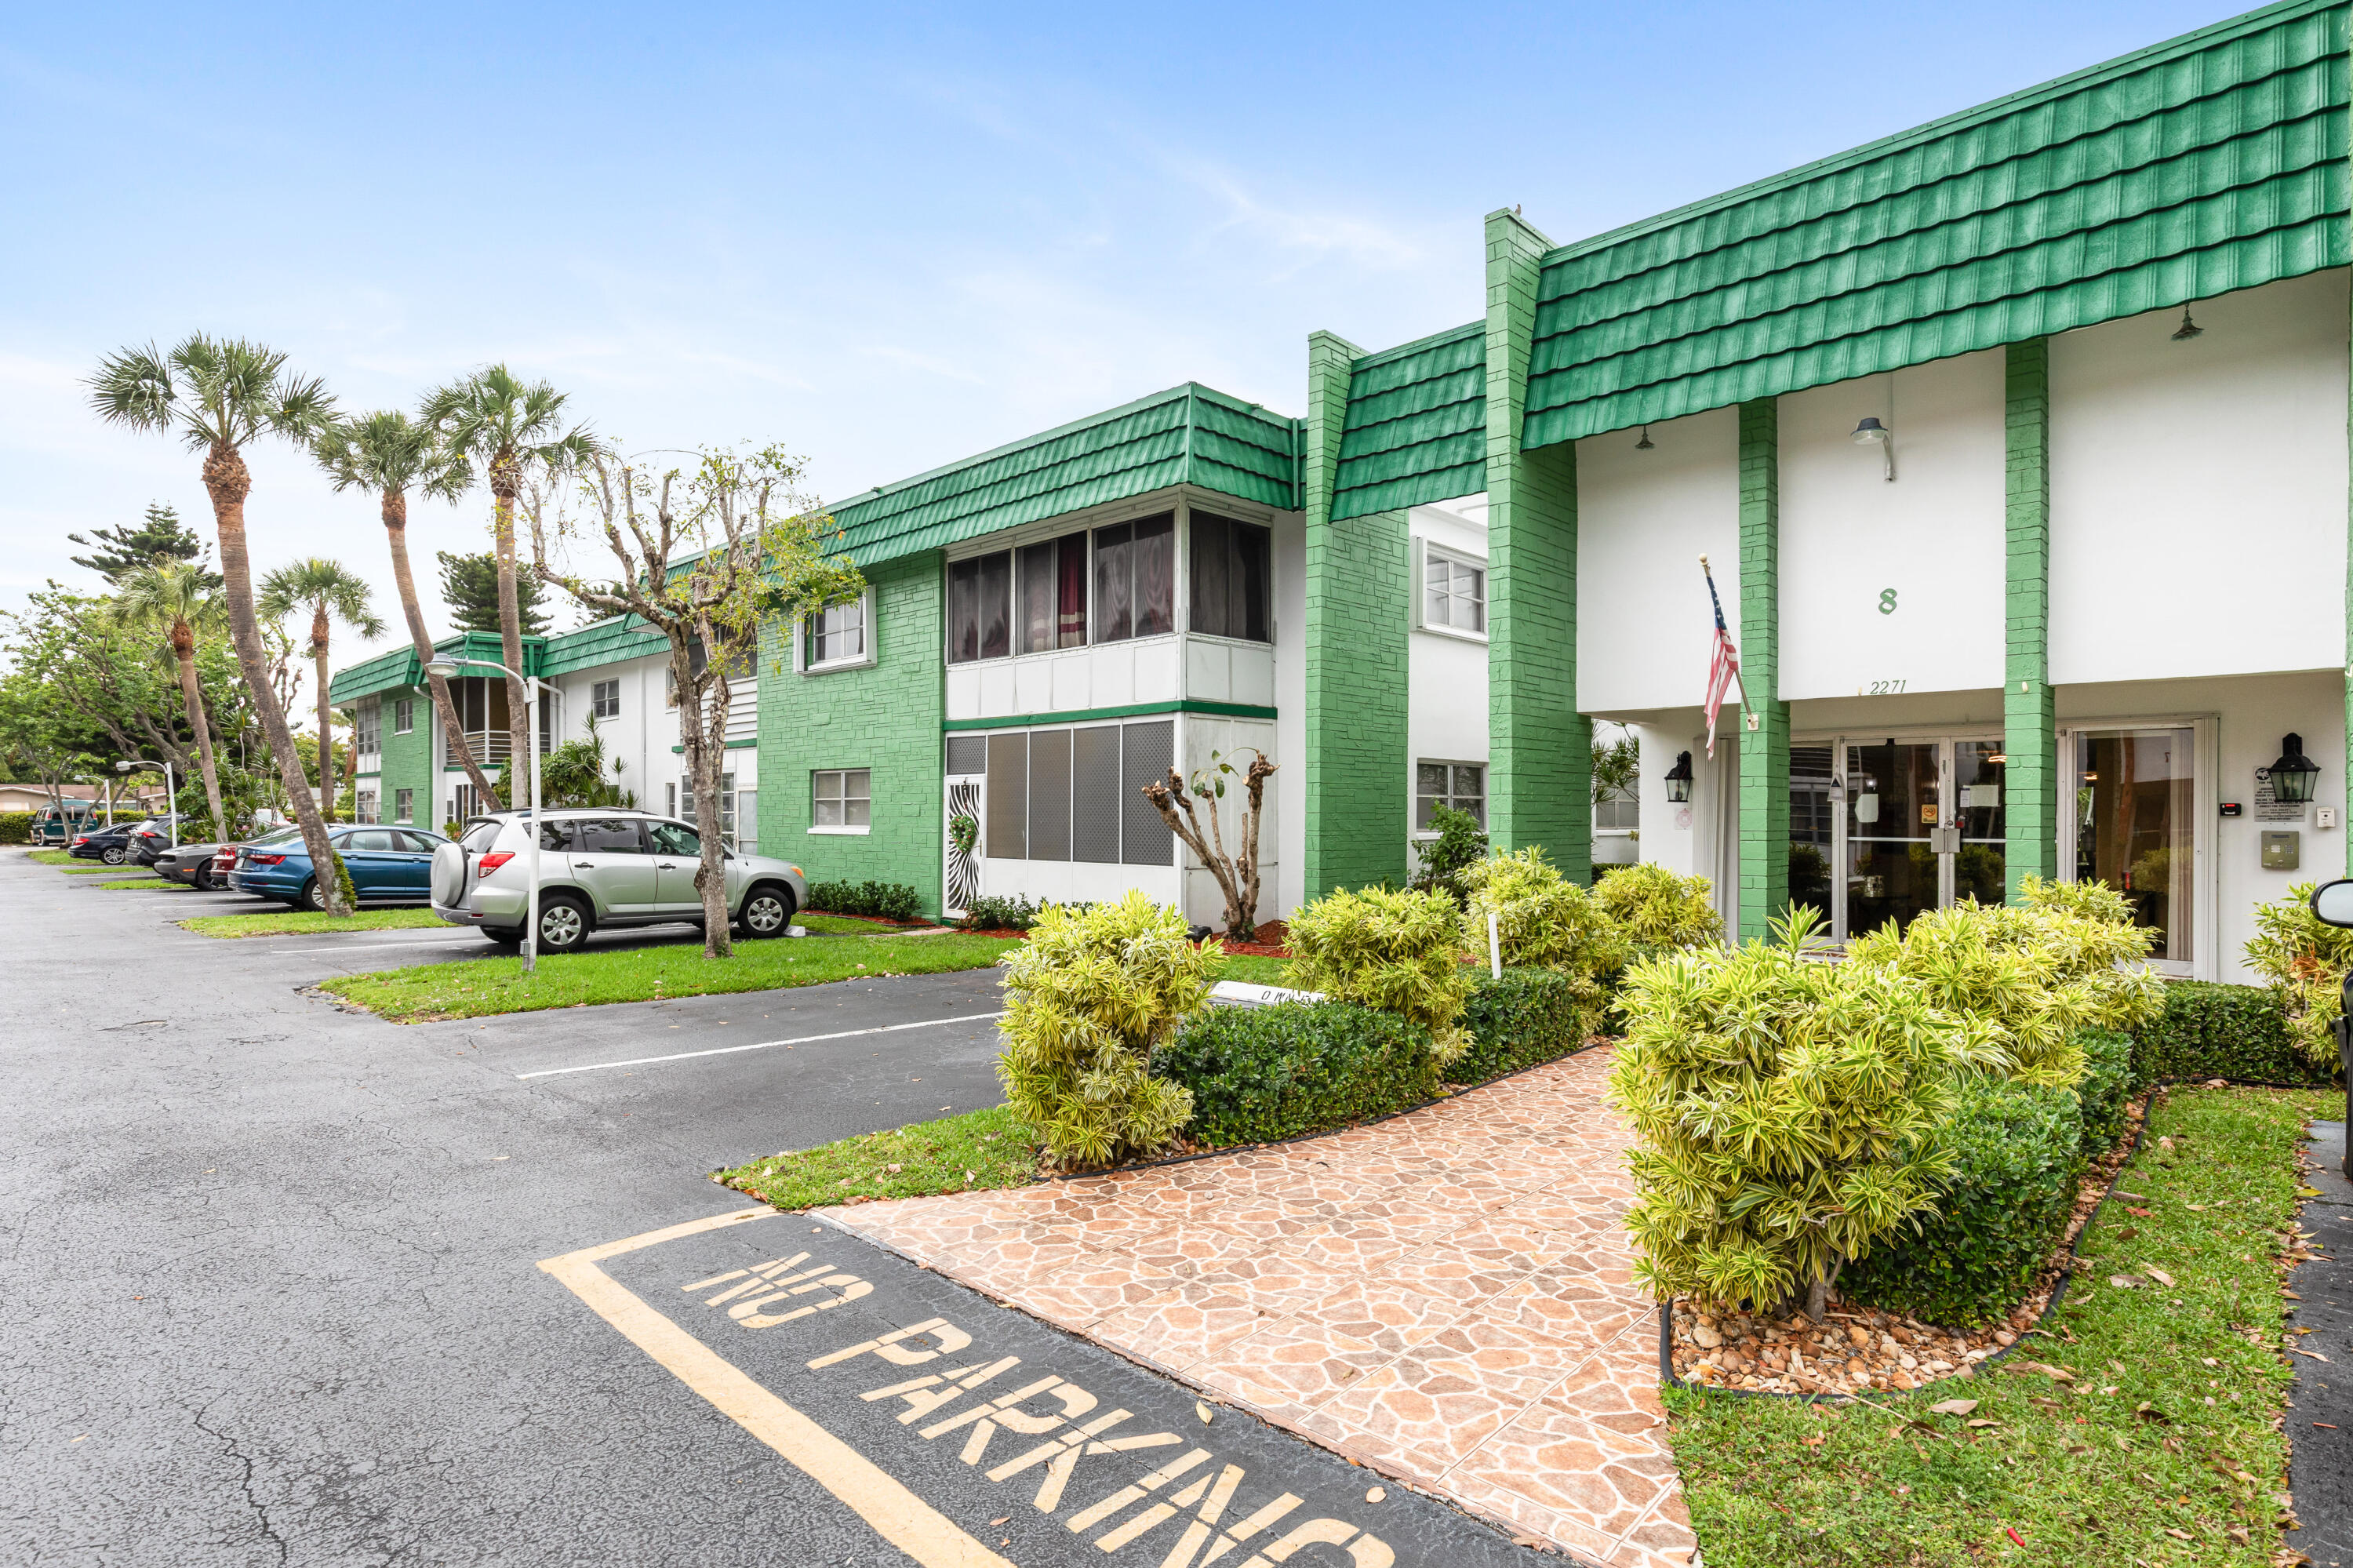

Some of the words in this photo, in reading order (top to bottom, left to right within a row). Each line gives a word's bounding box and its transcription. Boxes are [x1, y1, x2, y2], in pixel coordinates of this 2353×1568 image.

[1878, 588, 1897, 615] 8
[1870, 680, 1906, 694] 2271
[681, 1251, 874, 1328] NO
